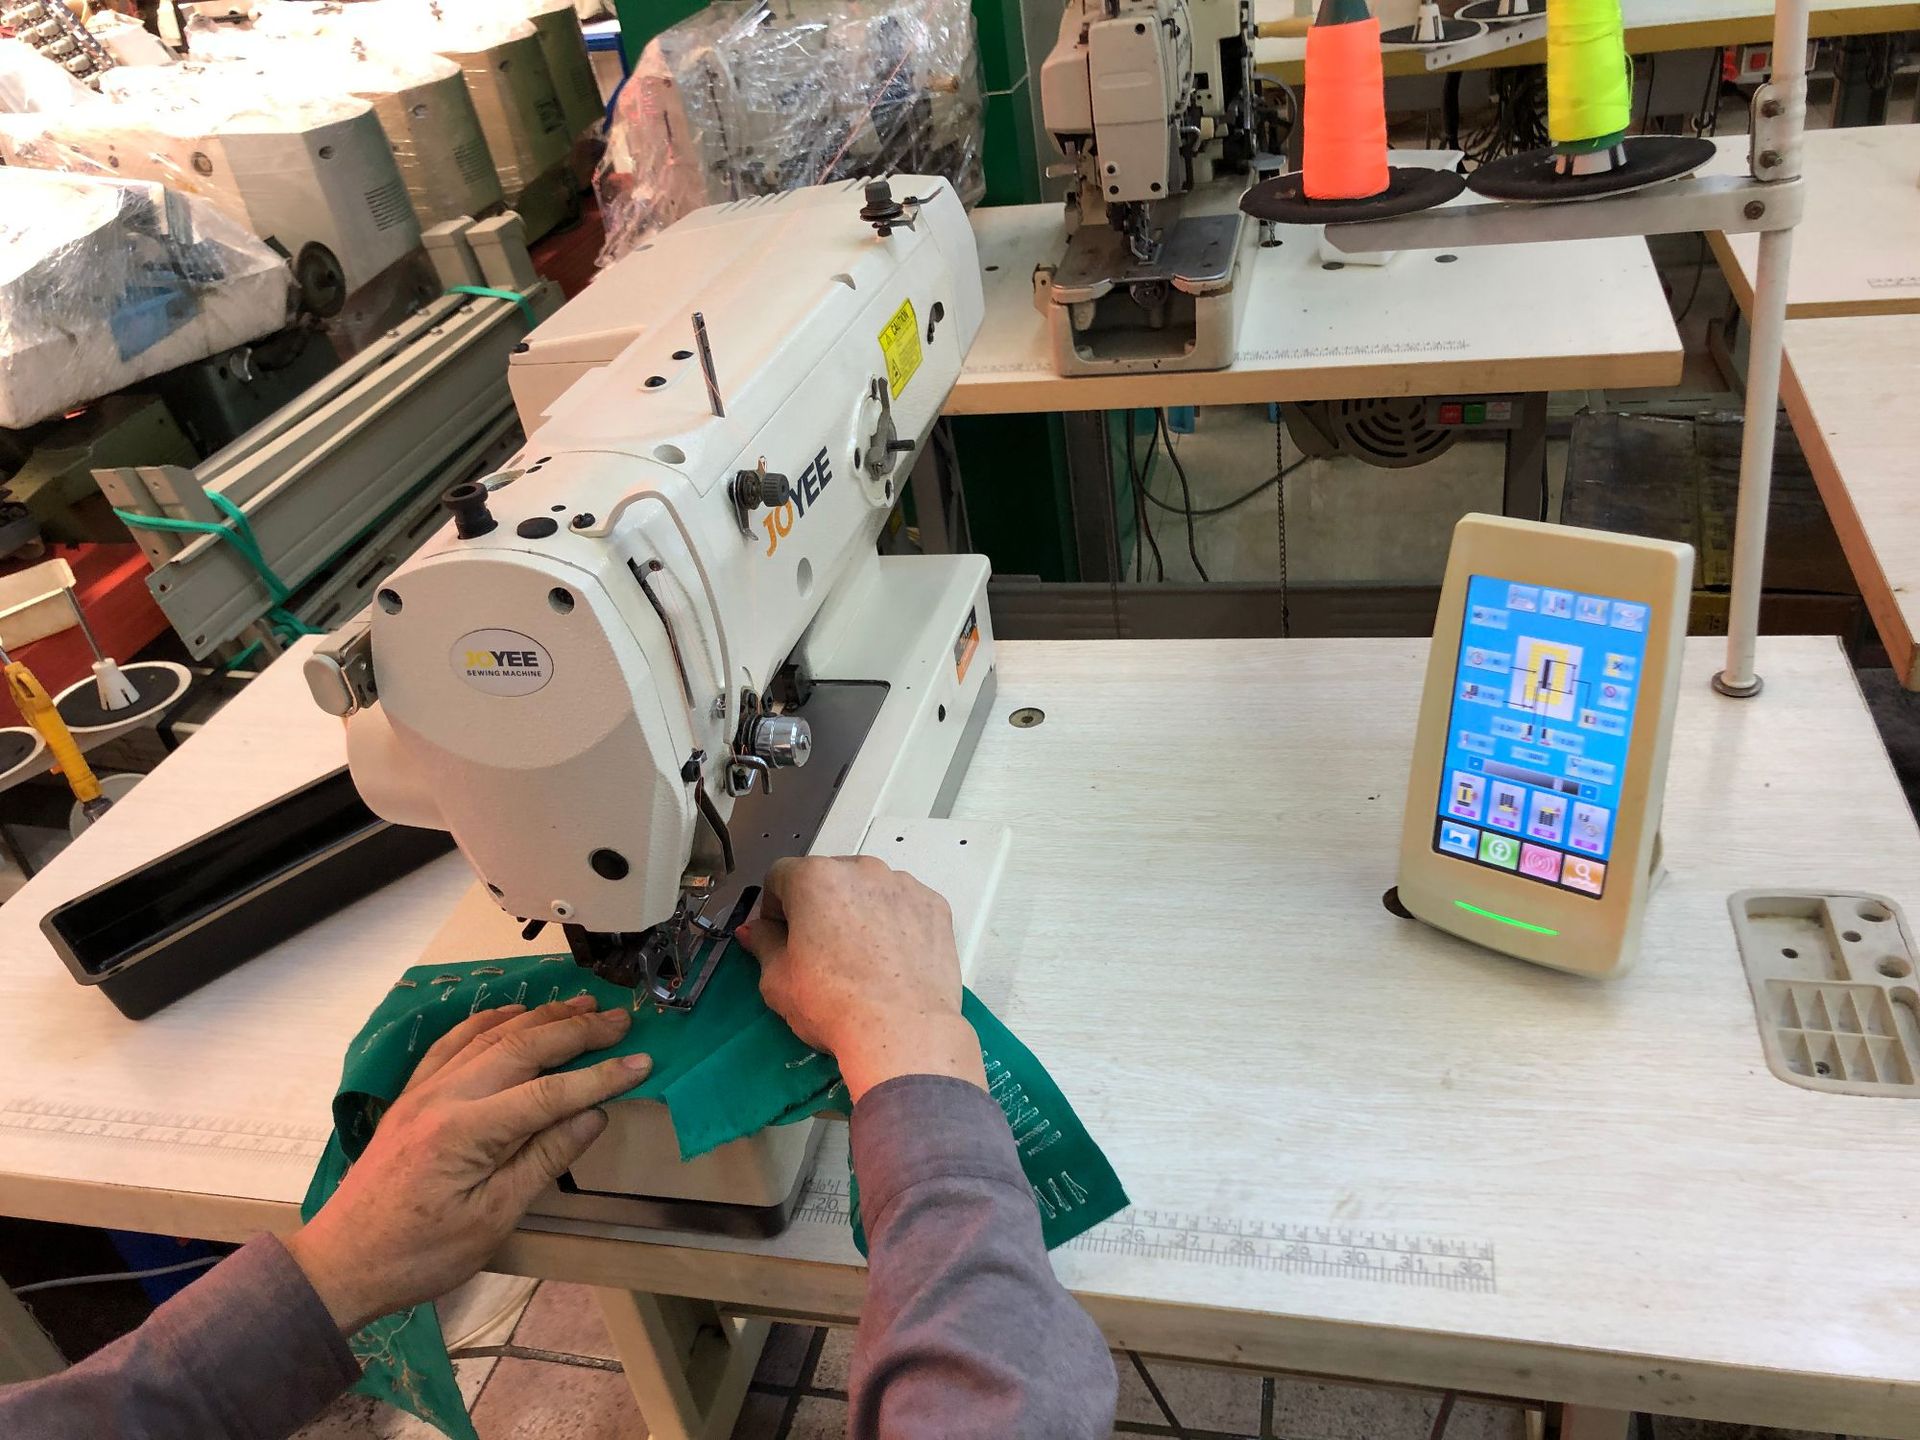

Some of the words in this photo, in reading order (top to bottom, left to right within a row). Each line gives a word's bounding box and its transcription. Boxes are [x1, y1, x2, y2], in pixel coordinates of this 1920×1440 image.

[762, 445, 833, 557] JOYEE
[464, 650, 539, 668] JOYEE
[466, 669, 501, 677] SEWING
[502, 669, 542, 678] MACHINE
[815, 1197, 838, 1211] 20
[1120, 1228, 1145, 1243] 26
[1175, 1231, 1200, 1247] 27
[1230, 1239, 1255, 1254] 28
[1285, 1244, 1310, 1261] 29
[1341, 1249, 1368, 1265] 30
[1399, 1254, 1425, 1270] 31
[1457, 1260, 1483, 1277] 32
